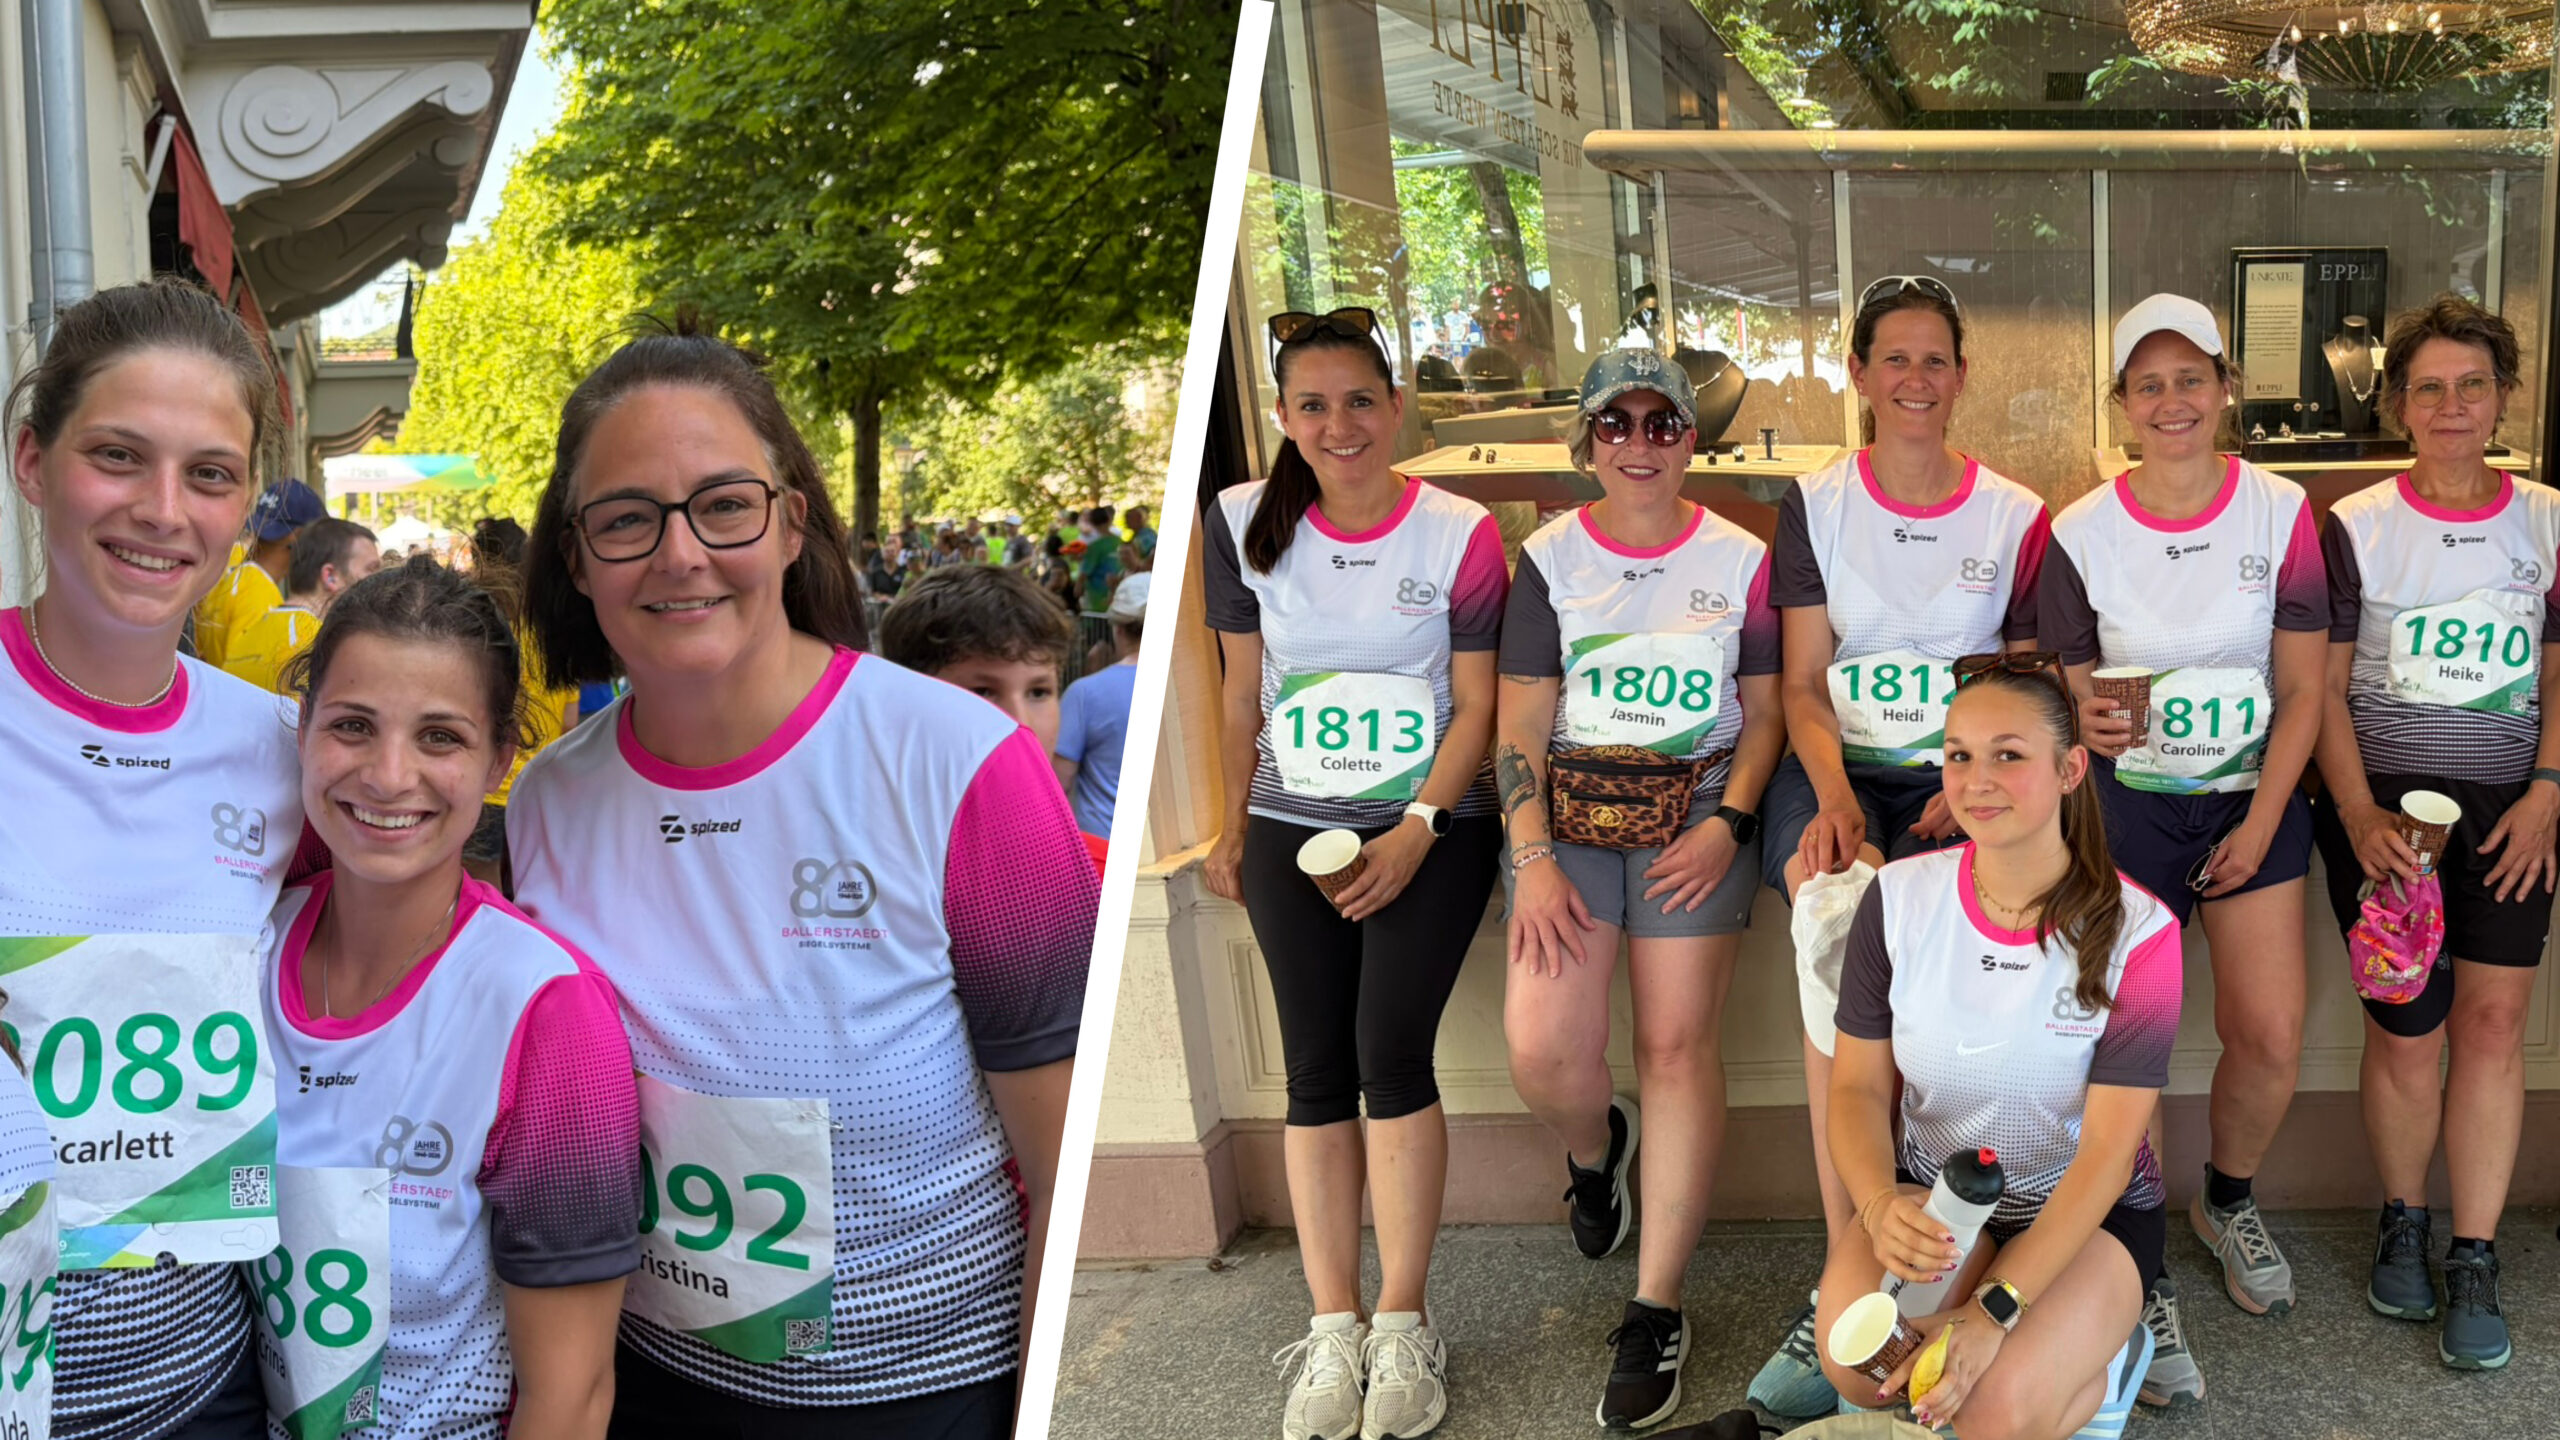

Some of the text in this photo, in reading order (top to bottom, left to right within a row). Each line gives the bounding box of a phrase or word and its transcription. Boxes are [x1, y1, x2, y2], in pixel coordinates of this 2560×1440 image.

[2319, 263, 2378, 281] EPPLI
[1910, 533, 1938, 543] spized
[2459, 536, 2486, 544] spized
[2183, 542, 2210, 554] spized
[1961, 557, 1998, 582] 80
[1396, 577, 1437, 606] 80
[1690, 589, 1729, 613] 80
[2405, 616, 2530, 668] 1810
[2439, 665, 2484, 682] Heike
[1579, 665, 1713, 712] 1808
[1610, 707, 1665, 728] Jasmin
[1883, 708, 1924, 723] Heidi
[2108, 709, 2131, 719] COFFEE
[1284, 706, 1424, 754] 1813
[2161, 742, 2226, 757] Caroline
[116, 756, 170, 769] spized
[1321, 756, 1382, 772] Colette
[211, 802, 267, 857] 80
[690, 818, 742, 836] spized
[790, 858, 877, 918] 80
[838, 881, 863, 891] JAHRE
[782, 926, 888, 939] BALLERSTAEDT
[799, 940, 872, 950] SIEGELSYSTEME
[0, 1011, 258, 1119] 089
[375, 1115, 453, 1177] 80
[414, 1140, 441, 1150] JAHRE
[388, 1183, 454, 1200] ERSTAEDT
[250, 1244, 373, 1348] 88
[259, 1332, 287, 1380] Crina
